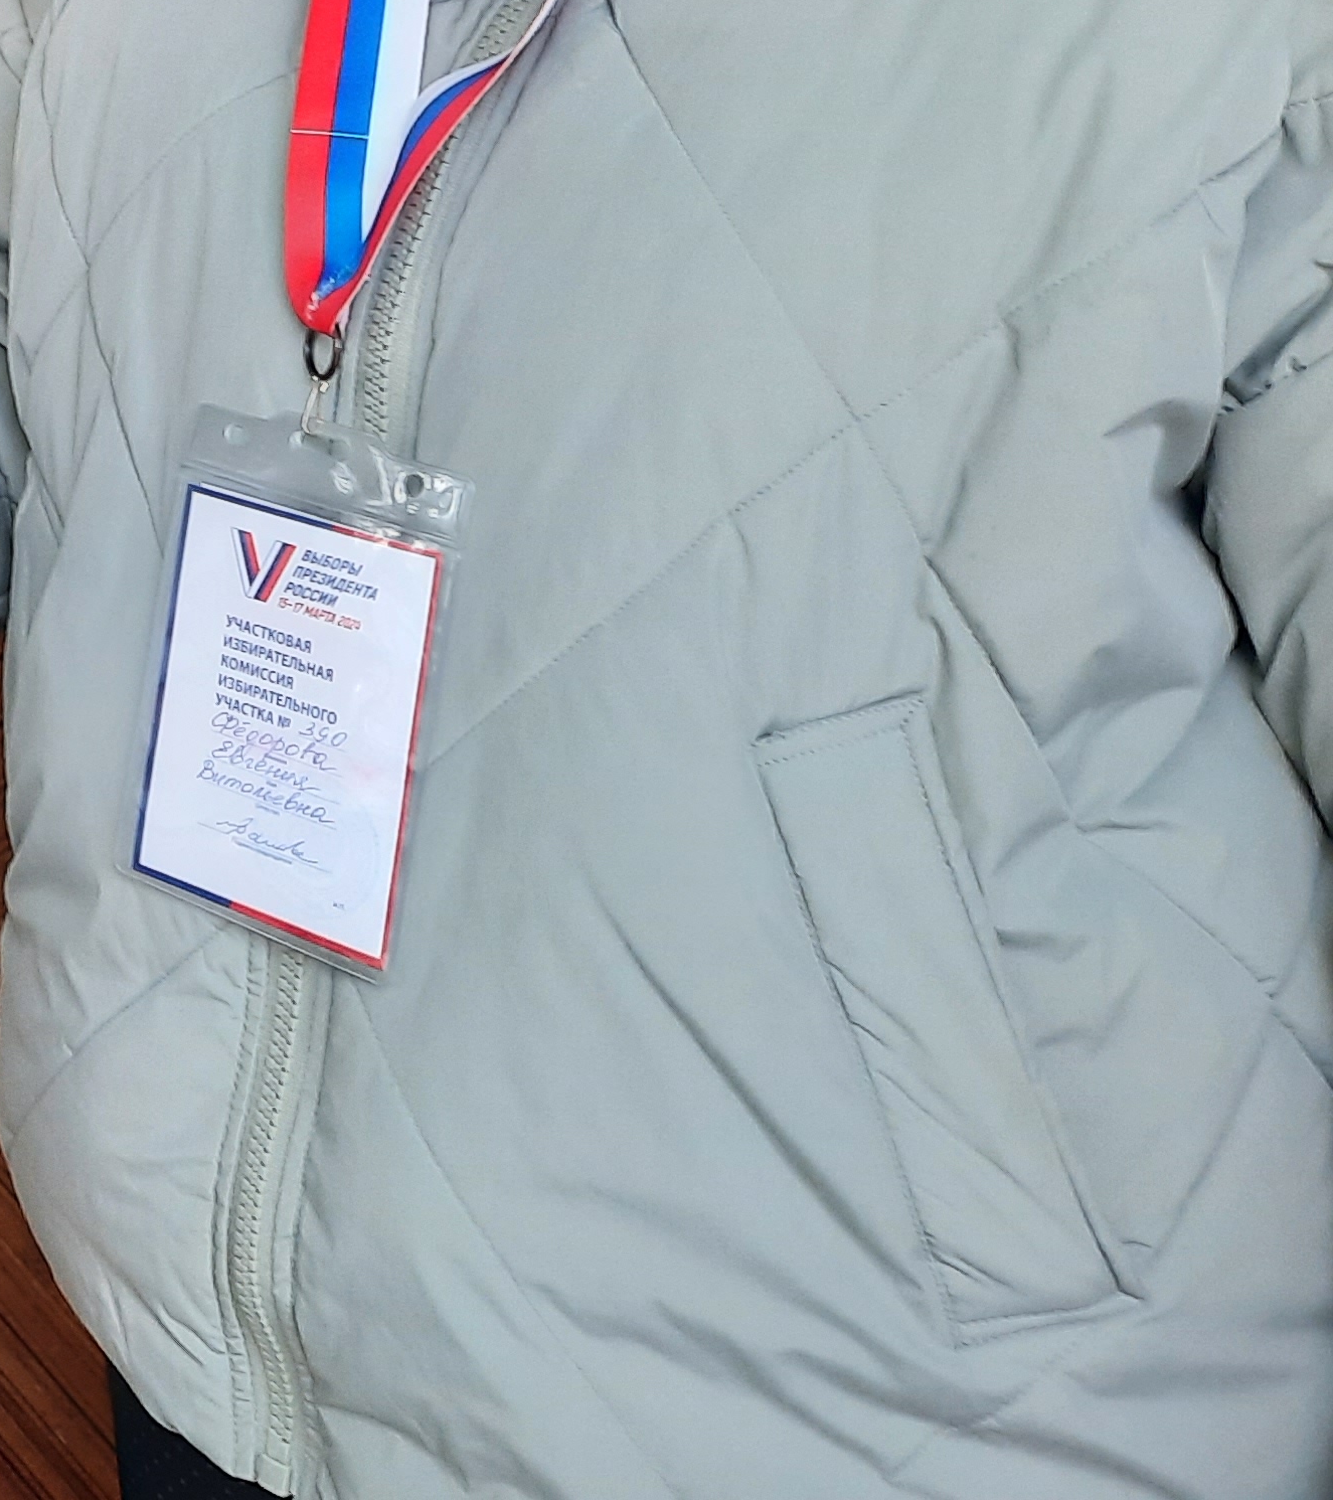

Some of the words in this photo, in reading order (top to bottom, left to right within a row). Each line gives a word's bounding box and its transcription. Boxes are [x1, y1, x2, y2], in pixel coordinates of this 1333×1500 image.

[301, 549, 364, 577] ВЫБОРЫ
[283, 581, 339, 607] РОССИИ
[292, 565, 379, 601] ПРЕЗИДЕНТА
[226, 614, 312, 654] УЧАСТКОВАЯ
[220, 654, 294, 690] КОМИССИЯ
[223, 635, 334, 682] ИЗБИРАТЕЛЬНАЯ
[215, 692, 274, 725] УЧАСТКА
[218, 673, 338, 725] ИЗБИРАТЕЛЬНОГО
